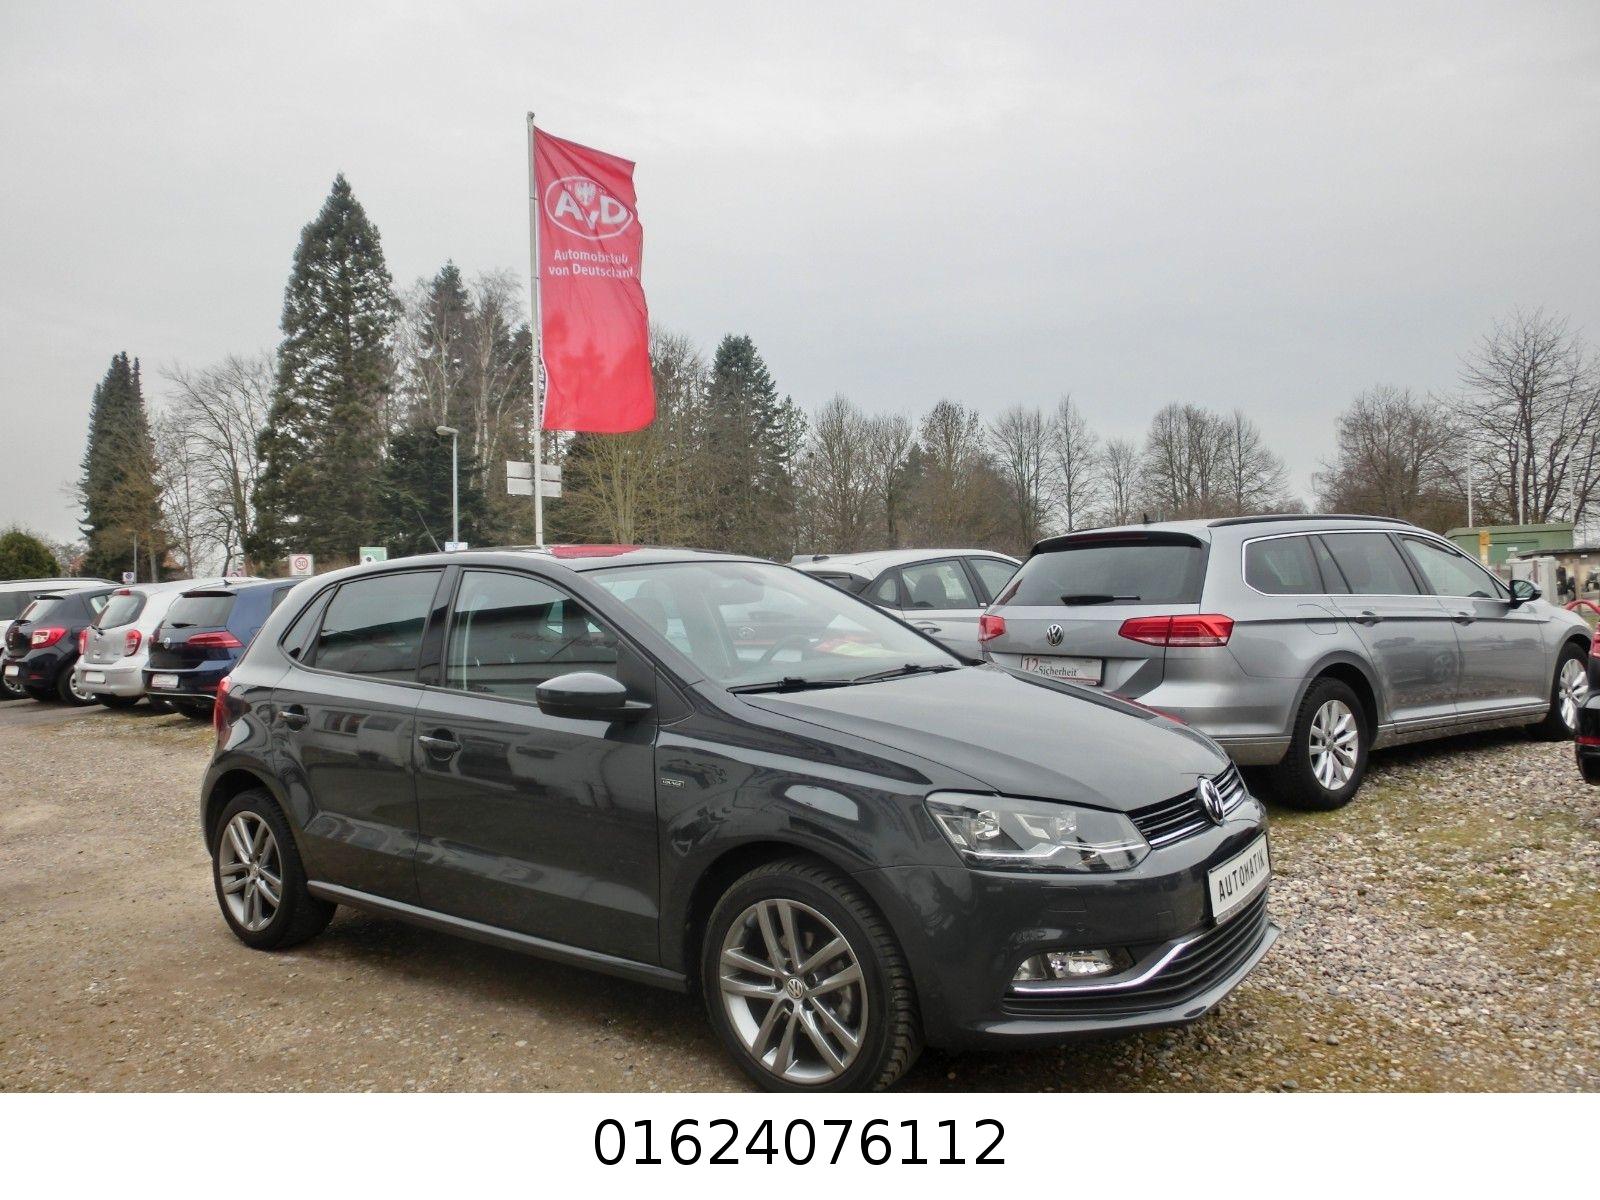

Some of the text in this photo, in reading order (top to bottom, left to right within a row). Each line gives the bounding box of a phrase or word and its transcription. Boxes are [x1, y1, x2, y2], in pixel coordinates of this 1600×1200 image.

[549, 265, 569, 276] von
[1024, 657, 1039, 673] 12
[1039, 665, 1077, 677] Sicherheit
[1218, 847, 1265, 902] AUTOMATIK
